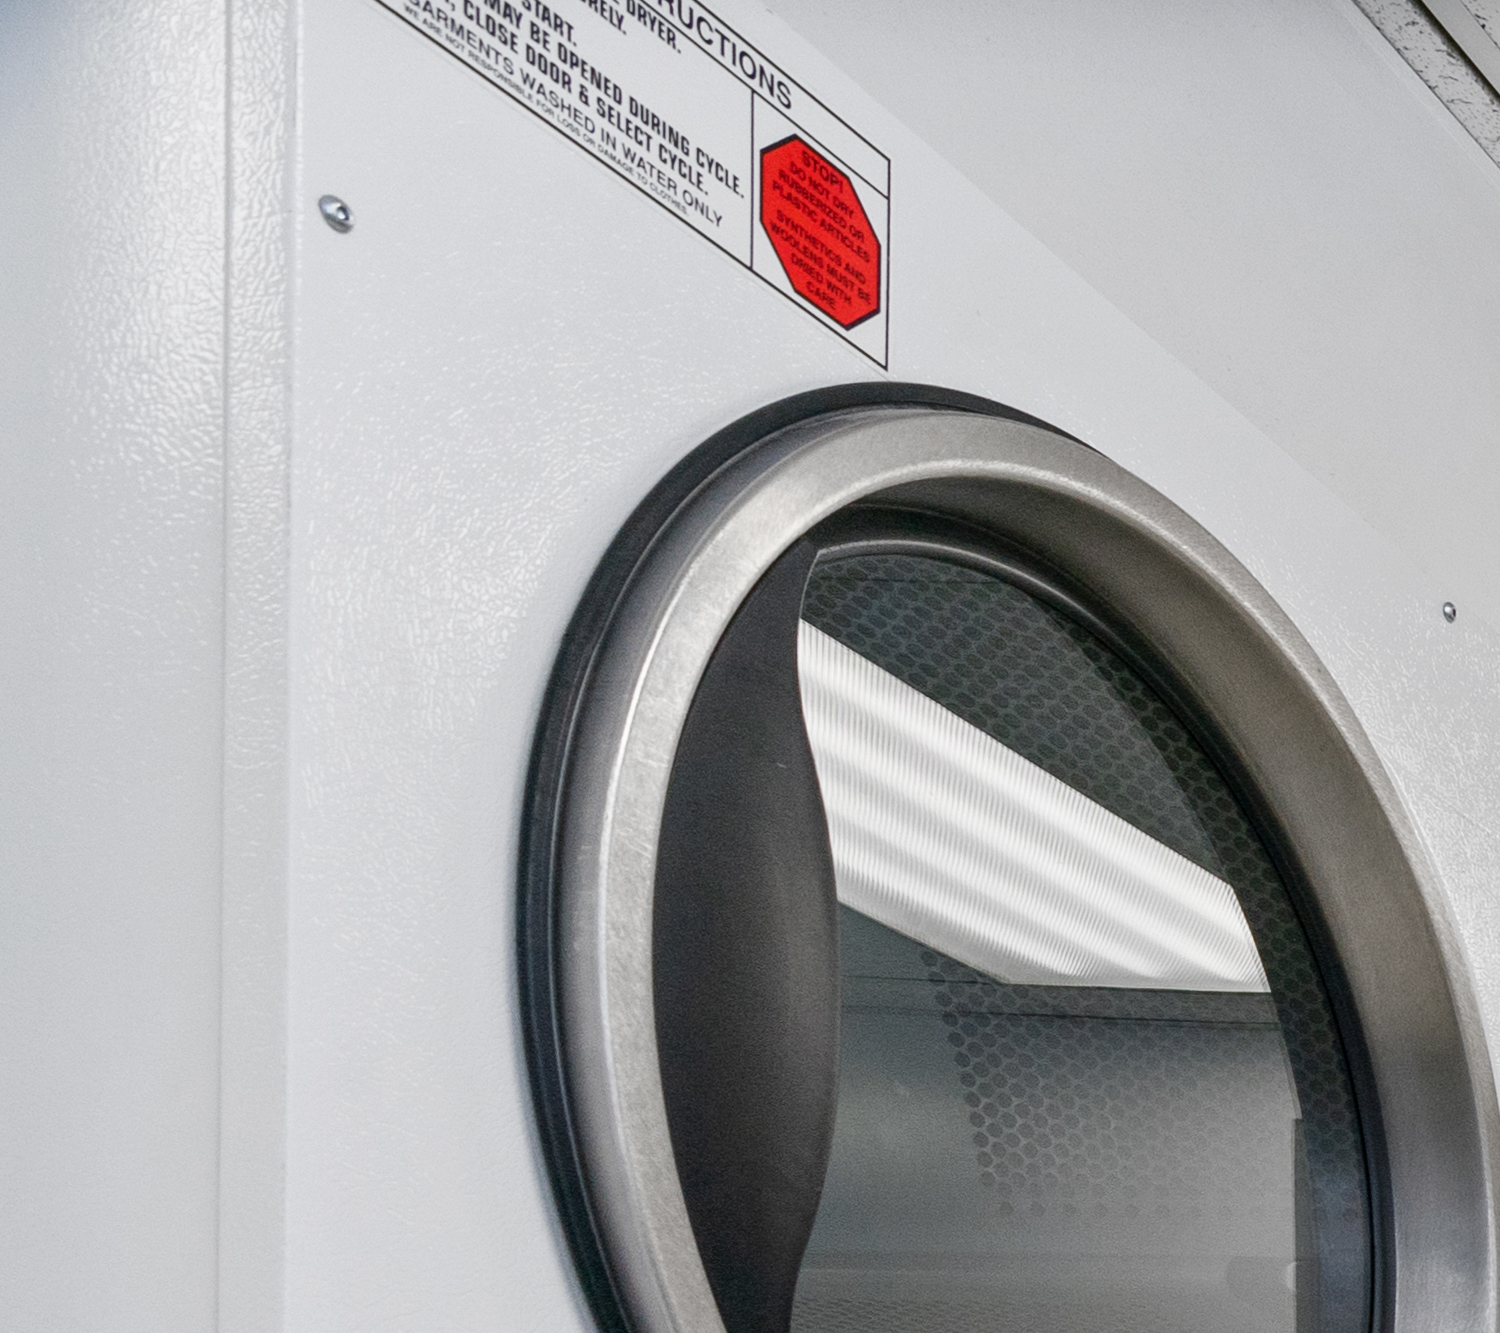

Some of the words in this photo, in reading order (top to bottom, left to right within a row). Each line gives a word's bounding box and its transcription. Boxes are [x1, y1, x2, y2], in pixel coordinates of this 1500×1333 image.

[463, 0, 519, 54] CLOSE
[525, 43, 572, 93] DOOR
[579, 84, 590, 107] &
[596, 97, 652, 152] SELECT
[659, 143, 709, 196] CYCLE.
[530, 20, 550, 53] BE
[558, 42, 622, 105] OPENED
[629, 96, 690, 157] DURING
[696, 147, 744, 198] CYCLE.
[520, 68, 596, 134] WASHED
[601, 128, 617, 151] IN
[622, 142, 678, 197] WATER
[683, 189, 723, 228] ONLY
[801, 150, 845, 194] STOP!
[772, 180, 818, 224] PLASTIC
[819, 218, 870, 264] ARTICLES
[778, 169, 847, 230] RUBBERIZED
[849, 225, 865, 244] OR
[790, 161, 807, 182] DO
[808, 176, 831, 197] NOT
[832, 196, 854, 219] DRY
[770, 220, 824, 269] WOOLENS
[826, 264, 855, 293] MUST
[857, 286, 872, 306] BE
[776, 210, 842, 267] SYNTHETICS
[844, 263, 866, 286] AND
[790, 252, 824, 284] DRIED
[826, 281, 852, 306] WITH
[806, 281, 836, 311] CARE
